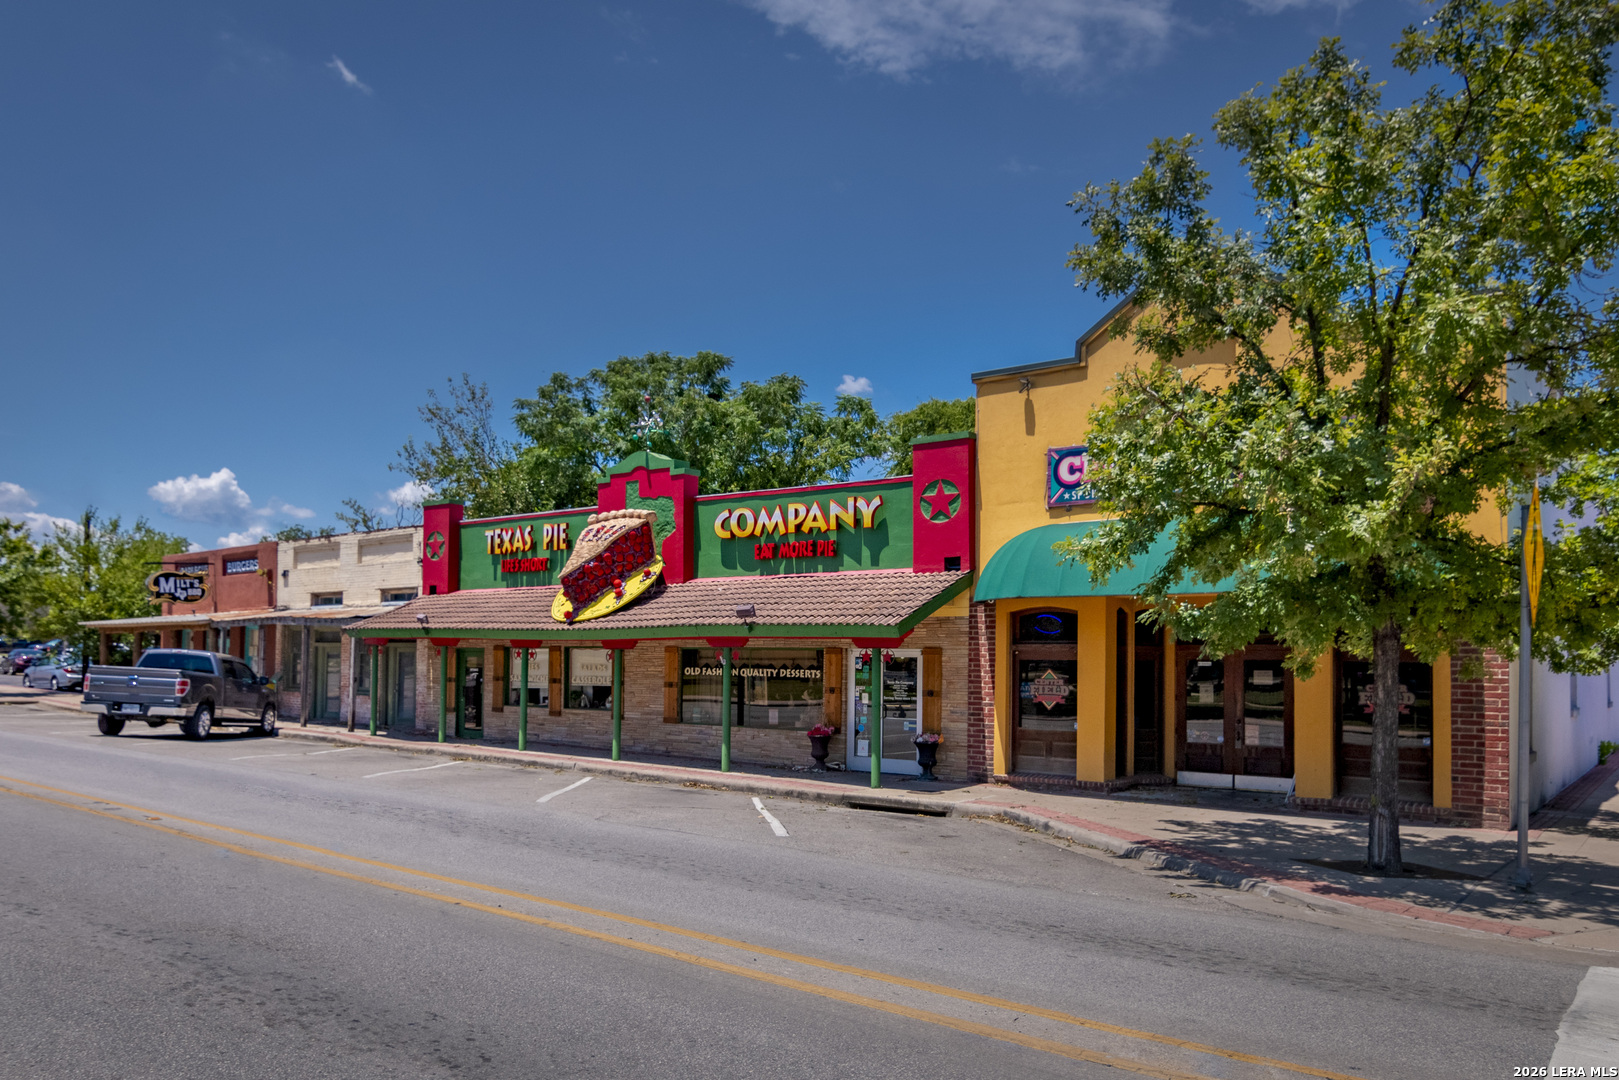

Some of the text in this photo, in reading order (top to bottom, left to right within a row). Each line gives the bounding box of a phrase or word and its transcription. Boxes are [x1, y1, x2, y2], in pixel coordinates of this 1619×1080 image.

[714, 495, 883, 538] COMPANY
[485, 523, 569, 555] TEXAS PIE
[754, 540, 836, 560] EAT MORE PIE
[227, 560, 259, 574] BURGERS
[501, 557, 549, 572] LIFE'S SHORT
[158, 576, 200, 593] MILT'S
[684, 667, 821, 678] OLD FASHN QUALITY DESSERTS
[1030, 685, 1069, 696] FIELD
